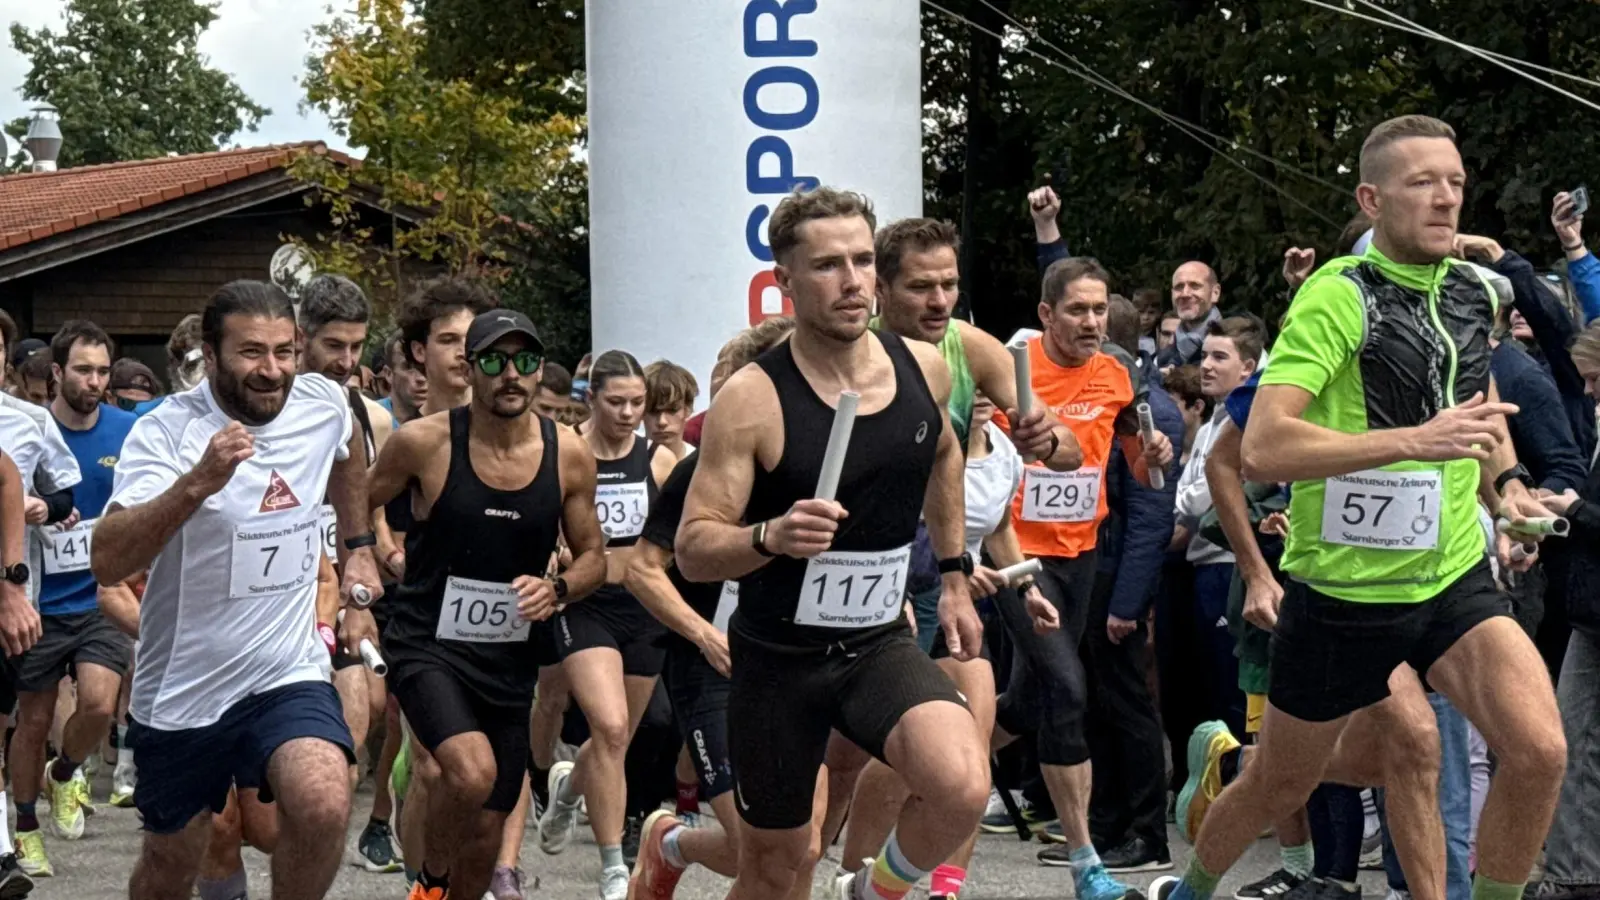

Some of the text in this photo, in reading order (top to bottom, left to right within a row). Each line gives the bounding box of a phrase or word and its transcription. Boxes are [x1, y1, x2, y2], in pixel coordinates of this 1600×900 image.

[1087, 482, 1092, 496] 1
[1400, 478, 1437, 489] Zeitung
[632, 498, 639, 512] 1
[1030, 483, 1079, 508] 129
[1418, 494, 1427, 514] 1
[484, 508, 513, 518] CRAFT
[1341, 493, 1394, 528] 57
[236, 519, 317, 541] Süddeutsche Zeitung
[1342, 532, 1416, 546] Starnberger SZ
[53, 535, 89, 560] 141
[304, 533, 311, 551] 1
[260, 545, 279, 577] 7
[813, 553, 907, 567] Süddeutsche Zeitung
[247, 574, 305, 594] Starnberger SZ
[450, 580, 505, 596] Süddeutsche
[891, 568, 899, 588] 1
[812, 572, 884, 607] 117
[450, 597, 509, 626] 105
[818, 610, 886, 623] Starnberger SZ
[693, 729, 713, 771] CRAFT
